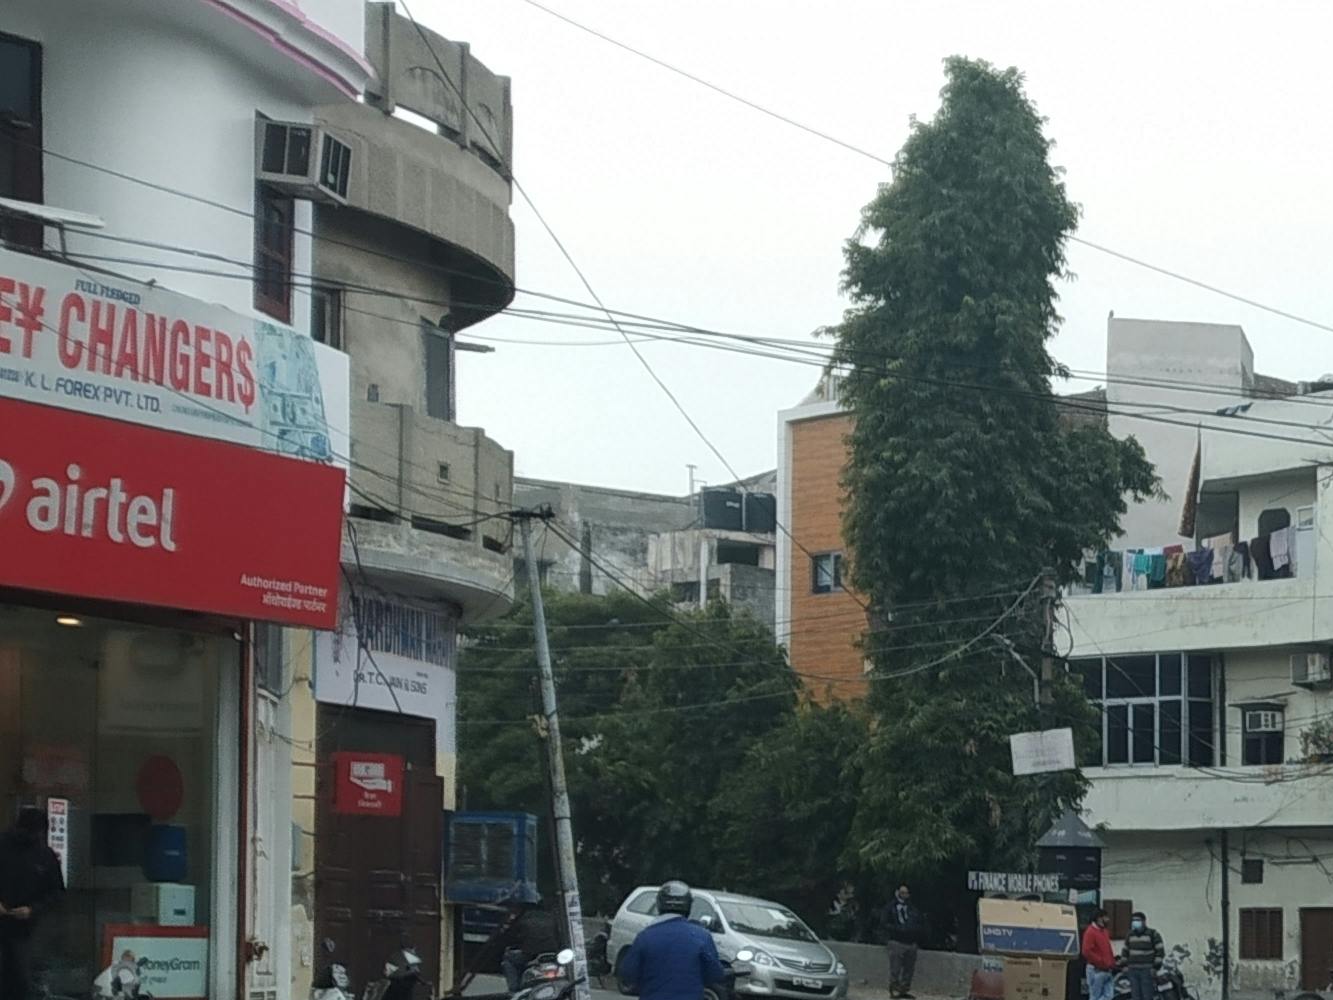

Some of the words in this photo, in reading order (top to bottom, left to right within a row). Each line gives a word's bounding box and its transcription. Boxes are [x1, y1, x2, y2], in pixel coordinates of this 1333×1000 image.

[56, 377, 100, 400] FOREX
[104, 388, 133, 407] PVT.
[136, 394, 162, 414] LTD.
[26, 463, 176, 552] airtel
[241, 573, 292, 593] Authorized
[294, 581, 328, 597] Partner
[978, 872, 1006, 891] FINANCE
[1008, 873, 1032, 892] MOBILE
[1033, 874, 1060, 892] PHONES
